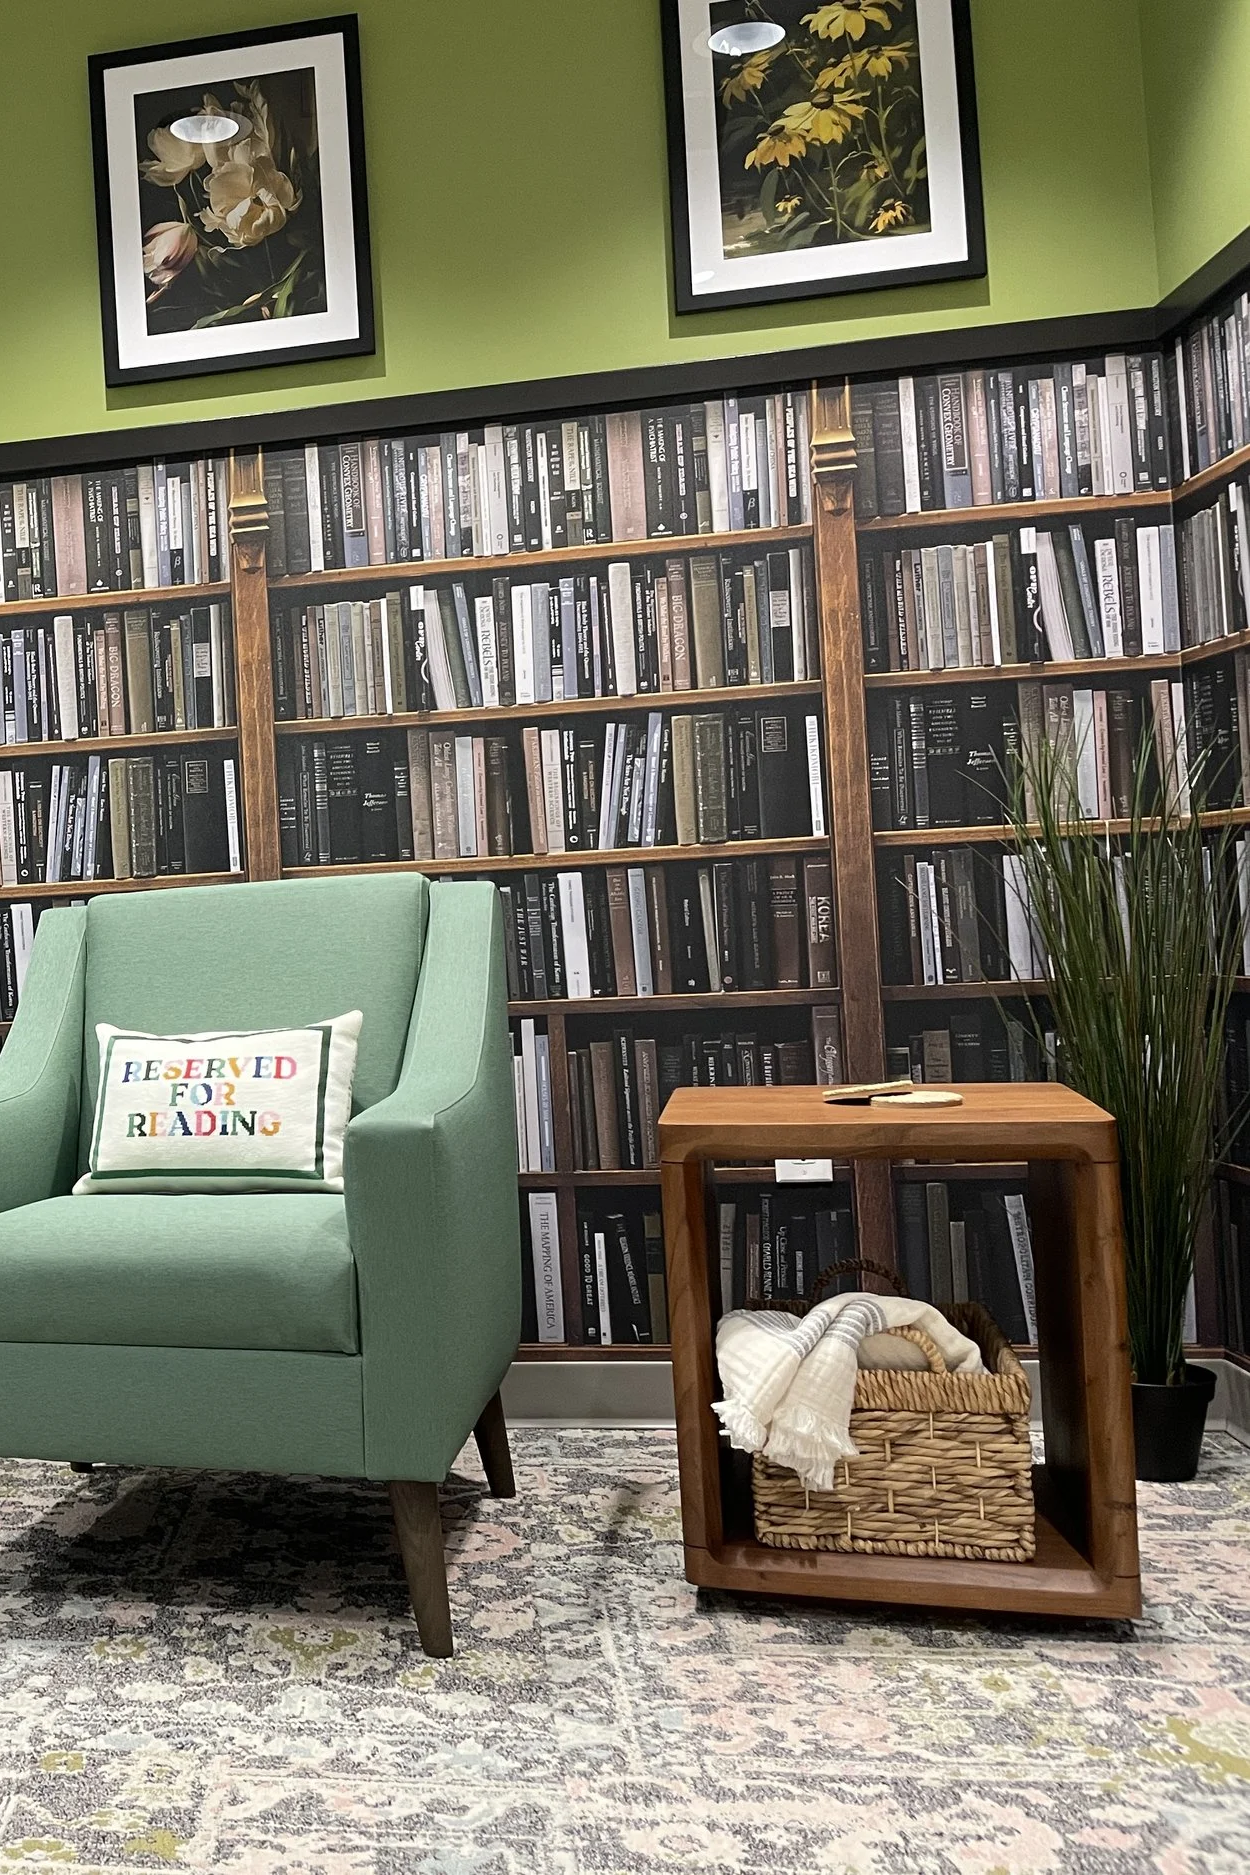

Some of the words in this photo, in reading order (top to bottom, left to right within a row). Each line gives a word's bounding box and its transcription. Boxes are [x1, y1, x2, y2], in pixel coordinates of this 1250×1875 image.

[942, 387, 952, 422] CONVEX
[952, 387, 962, 434] HANDBOOK
[944, 423, 955, 466] GEOMETRY
[954, 435, 962, 445] OF
[342, 454, 351, 487] CONVEX
[351, 454, 360, 498] HANDBOOK
[344, 488, 354, 528] GEOMETRY
[353, 499, 360, 509] OF
[914, 562, 923, 595] Luther
[672, 594, 683, 613] BIG
[318, 618, 326, 648] Luther
[673, 615, 686, 660] DRAGON
[817, 896, 832, 943] KOREA
[518, 926, 526, 946] JUST
[122, 1056, 298, 1083] RESERVED
[169, 1082, 236, 1107] FOR
[126, 1110, 282, 1138] READING
[540, 1211, 549, 1230] THE
[541, 1231, 552, 1272] MAPPING
[763, 1242, 771, 1270] CHARLES
[543, 1274, 553, 1287] OF
[763, 1270, 772, 1292] RENNIE
[544, 1287, 555, 1329] AMERICA
